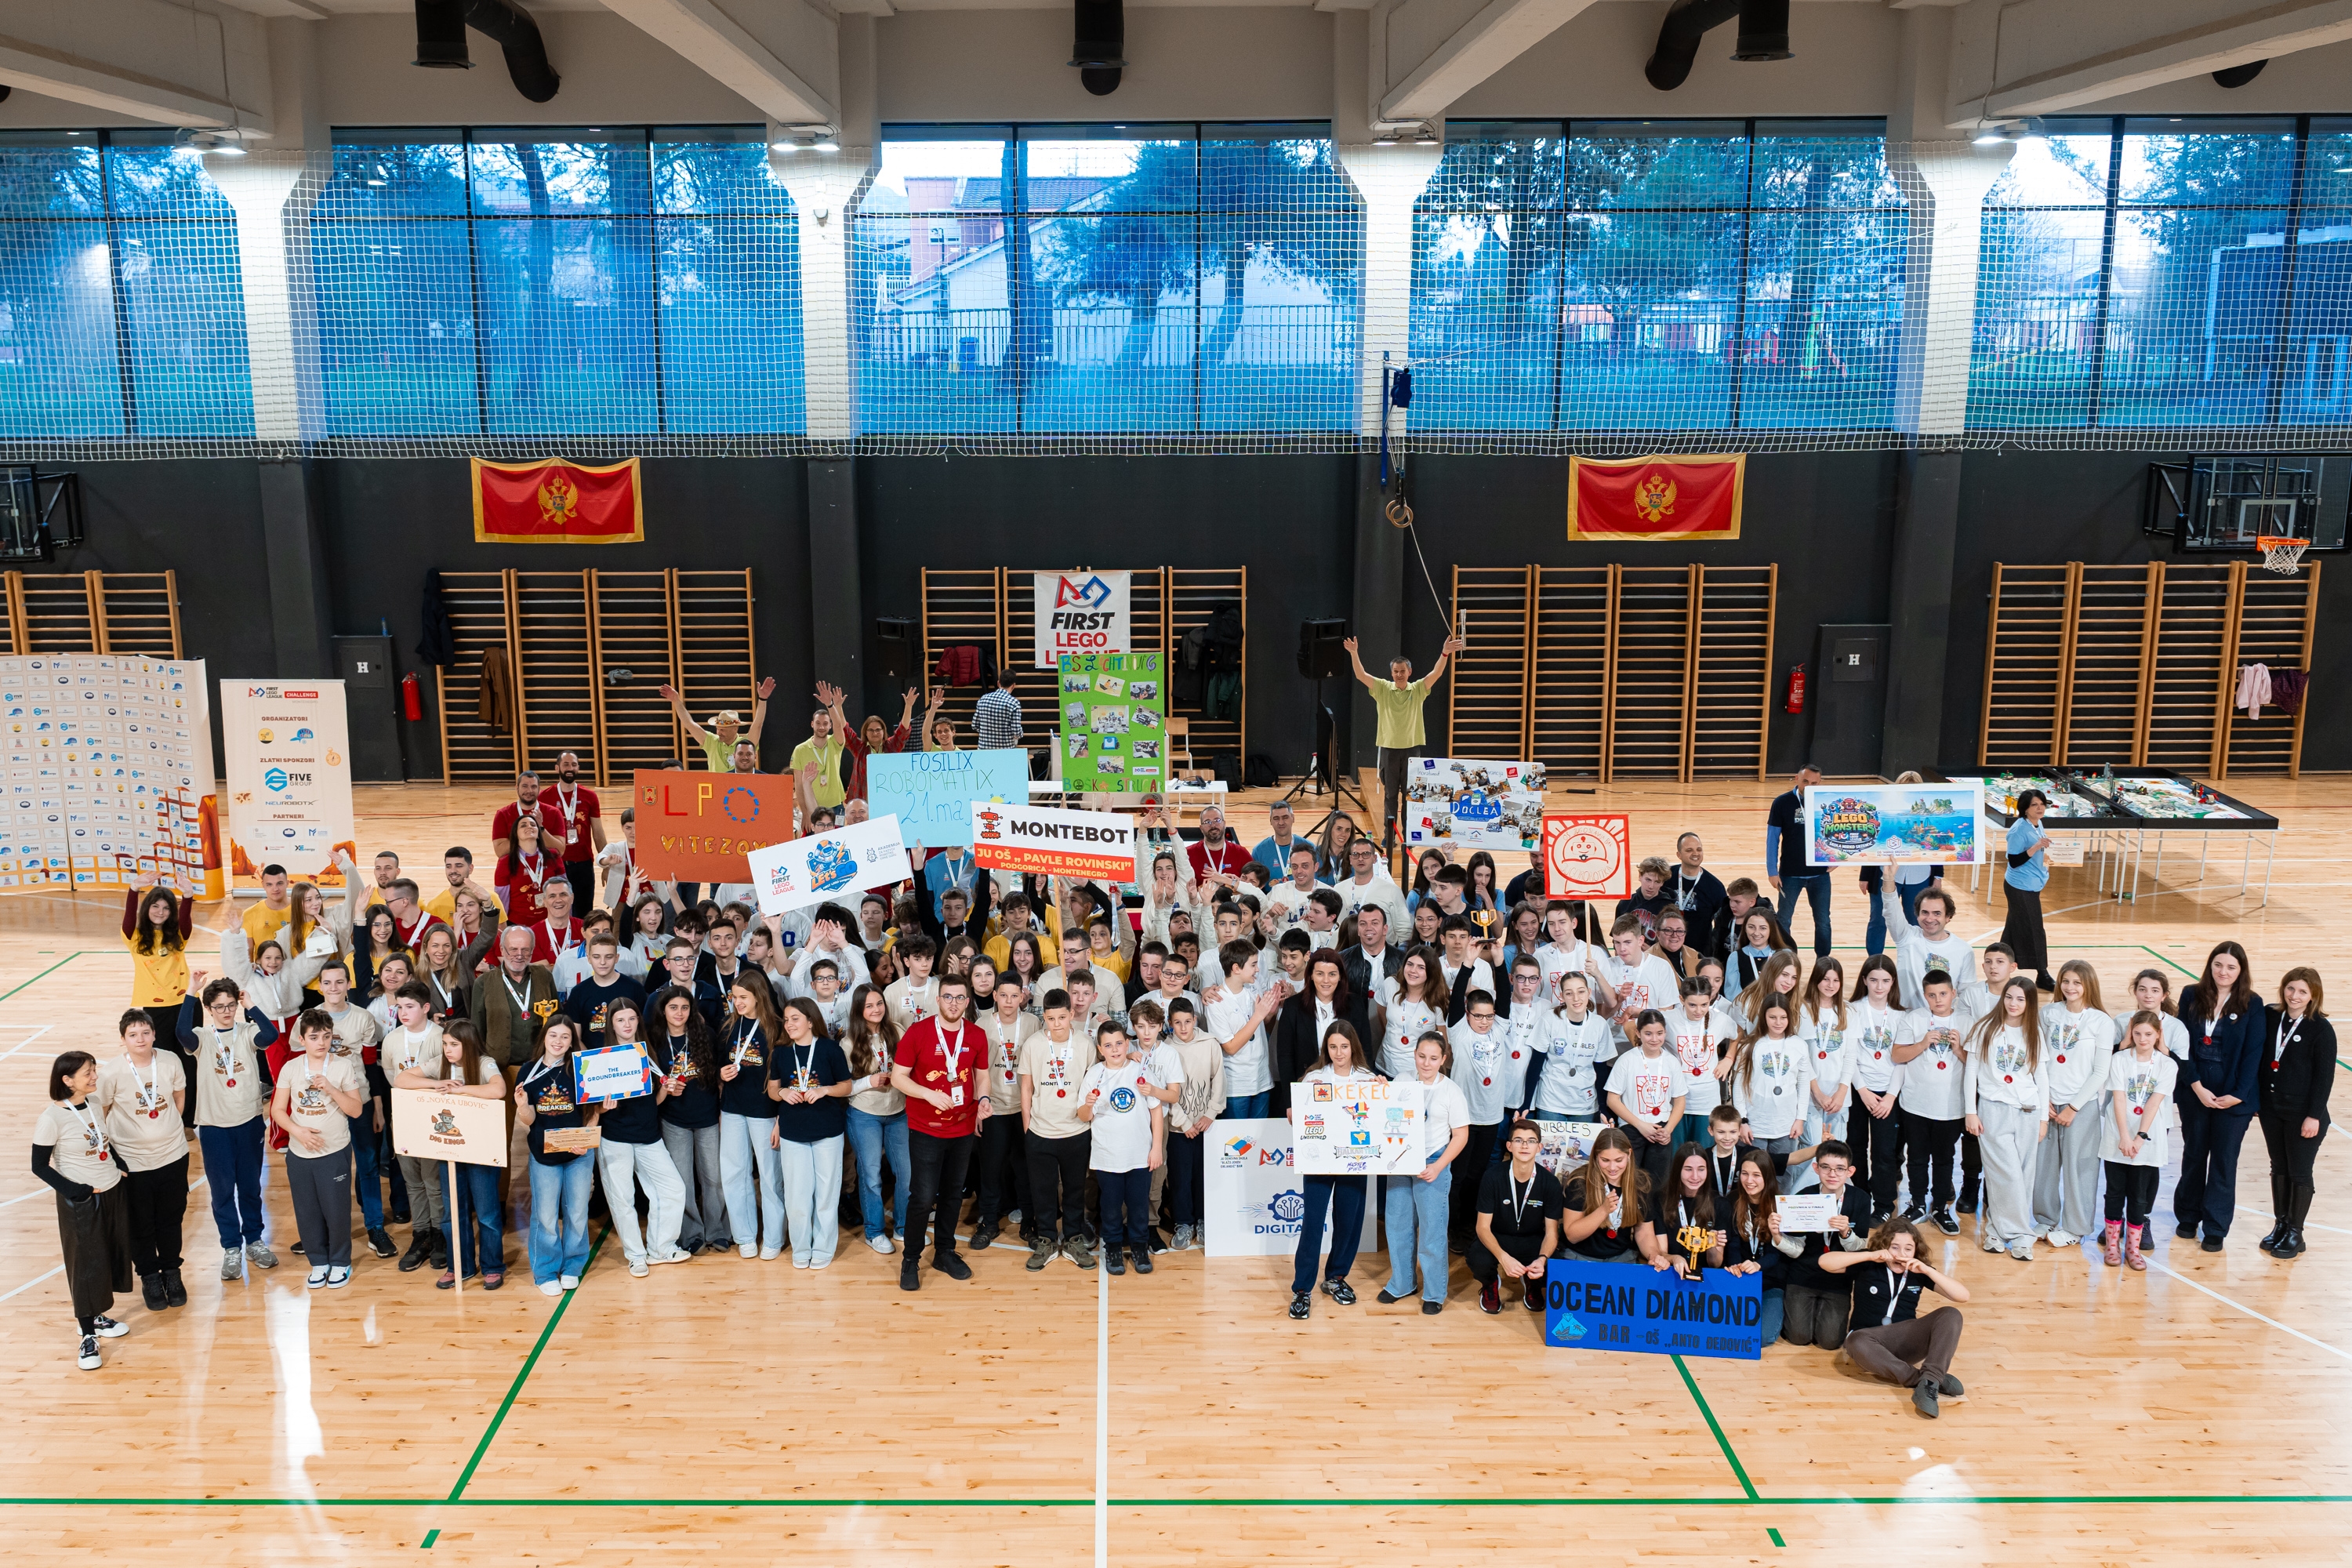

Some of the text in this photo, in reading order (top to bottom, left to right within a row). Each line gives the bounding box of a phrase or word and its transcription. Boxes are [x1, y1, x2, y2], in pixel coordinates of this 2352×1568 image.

[1051, 612, 1115, 630] FIRST
[1056, 632, 1107, 648] LEGO
[1060, 655, 1081, 673] BS
[911, 752, 973, 771] FOSILIX
[1452, 802, 1498, 816] DOCLEA
[1833, 813, 1867, 823] LEGO
[1011, 820, 1128, 844] MONTEBOT
[1825, 824, 1875, 835] MONSTERS
[661, 835, 779, 856] VITEZOV
[977, 848, 991, 858] JU
[994, 848, 1011, 860] OŠ
[1023, 852, 1063, 866] PAVLE
[835, 861, 857, 877] GO
[1000, 862, 1047, 873] PODGORICA
[1053, 867, 1109, 878] MONTENEGRO
[771, 875, 790, 885] FIRST
[774, 881, 790, 890] LEGO
[772, 885, 795, 895] LEAGUE
[587, 1069, 641, 1083] GROUNDBREAKERS
[1305, 1126, 1324, 1134] LEGO
[429, 1134, 442, 1143] DIG
[1548, 1280, 1761, 1327] OCEAN DIAMOND
[1599, 1323, 1630, 1344] BAR
